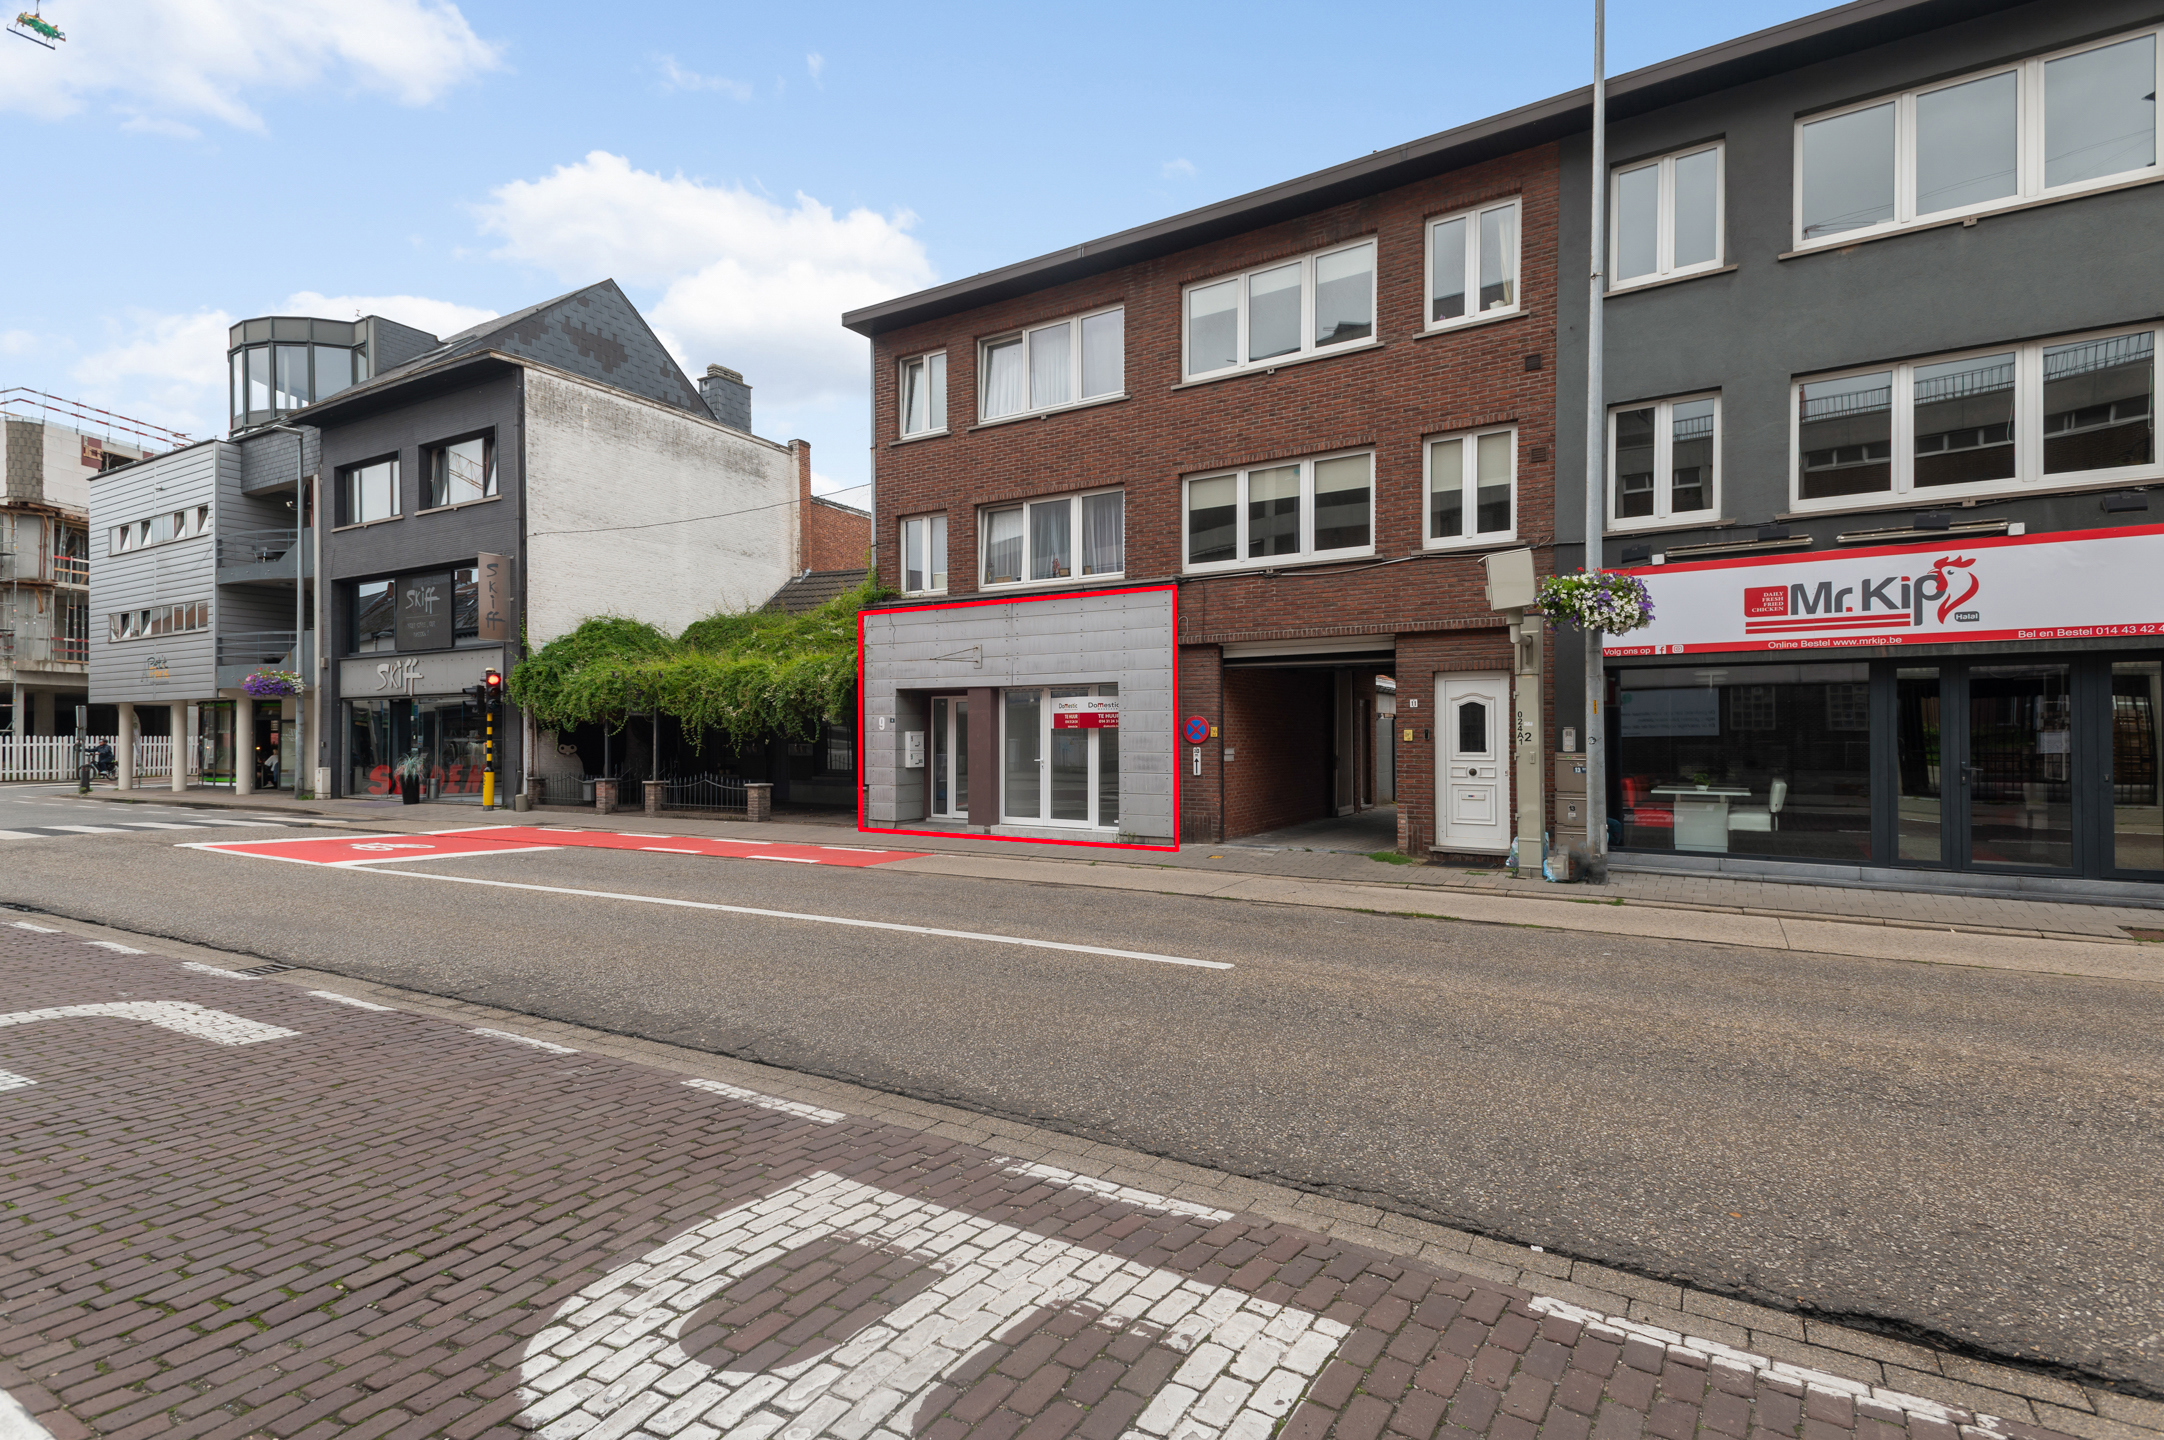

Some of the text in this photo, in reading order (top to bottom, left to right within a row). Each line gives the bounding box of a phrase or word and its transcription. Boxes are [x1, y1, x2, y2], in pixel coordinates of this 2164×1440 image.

[1790, 575, 1947, 627] Mr. Kip
[1955, 612, 1979, 621] Halal
[2018, 630, 2036, 638] Bel
[2057, 627, 2093, 637] Bestel
[2096, 626, 2118, 635] 014
[2121, 625, 2137, 634] 43
[2140, 624, 2156, 633] 42
[1768, 636, 1903, 649] Online Bestel www.mrkip.be
[1603, 648, 1622, 657] Volg
[1640, 648, 1651, 656] op
[879, 716, 885, 731] 9
[1524, 732, 1532, 742] 2
